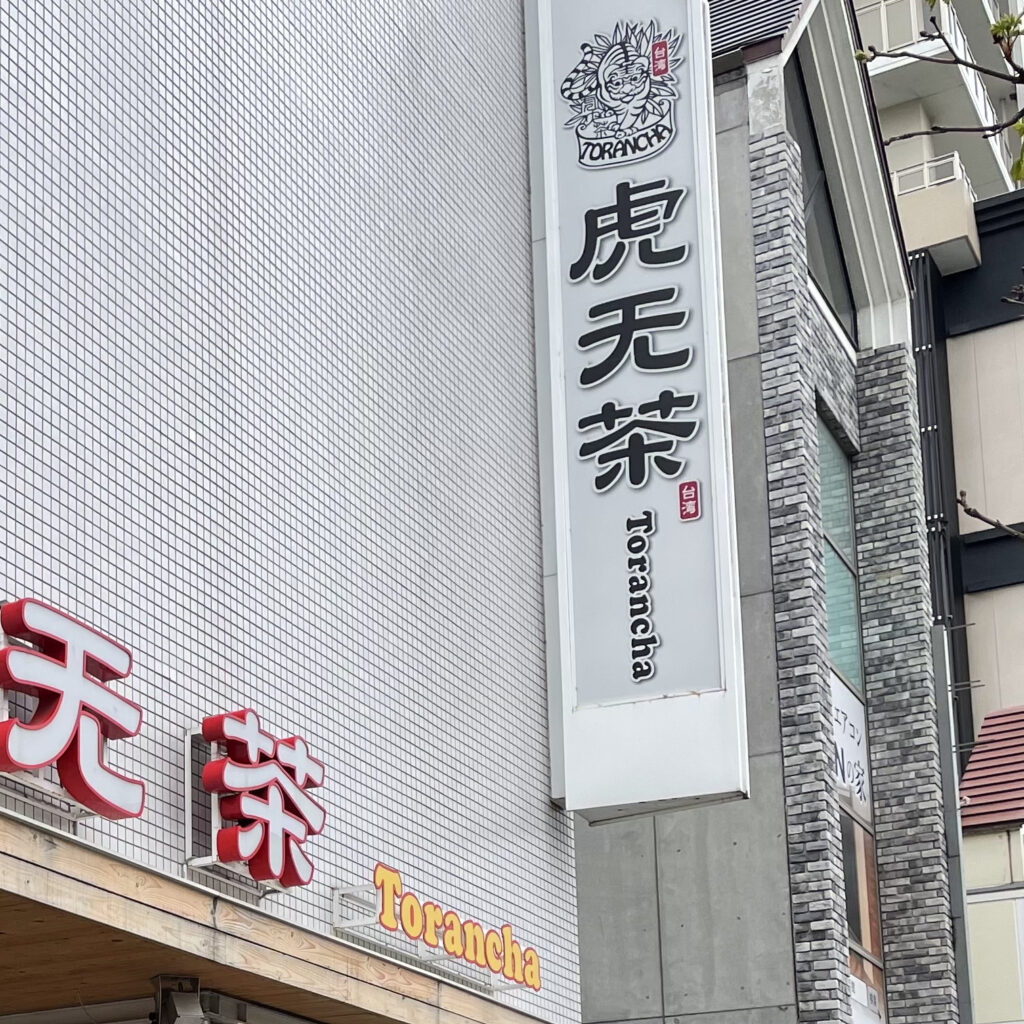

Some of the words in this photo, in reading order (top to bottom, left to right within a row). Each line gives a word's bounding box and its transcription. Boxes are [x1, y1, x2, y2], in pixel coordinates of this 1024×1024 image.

[580, 124, 672, 161] TORANCHA
[626, 510, 660, 681] Torancha
[374, 861, 542, 992] Torancha
